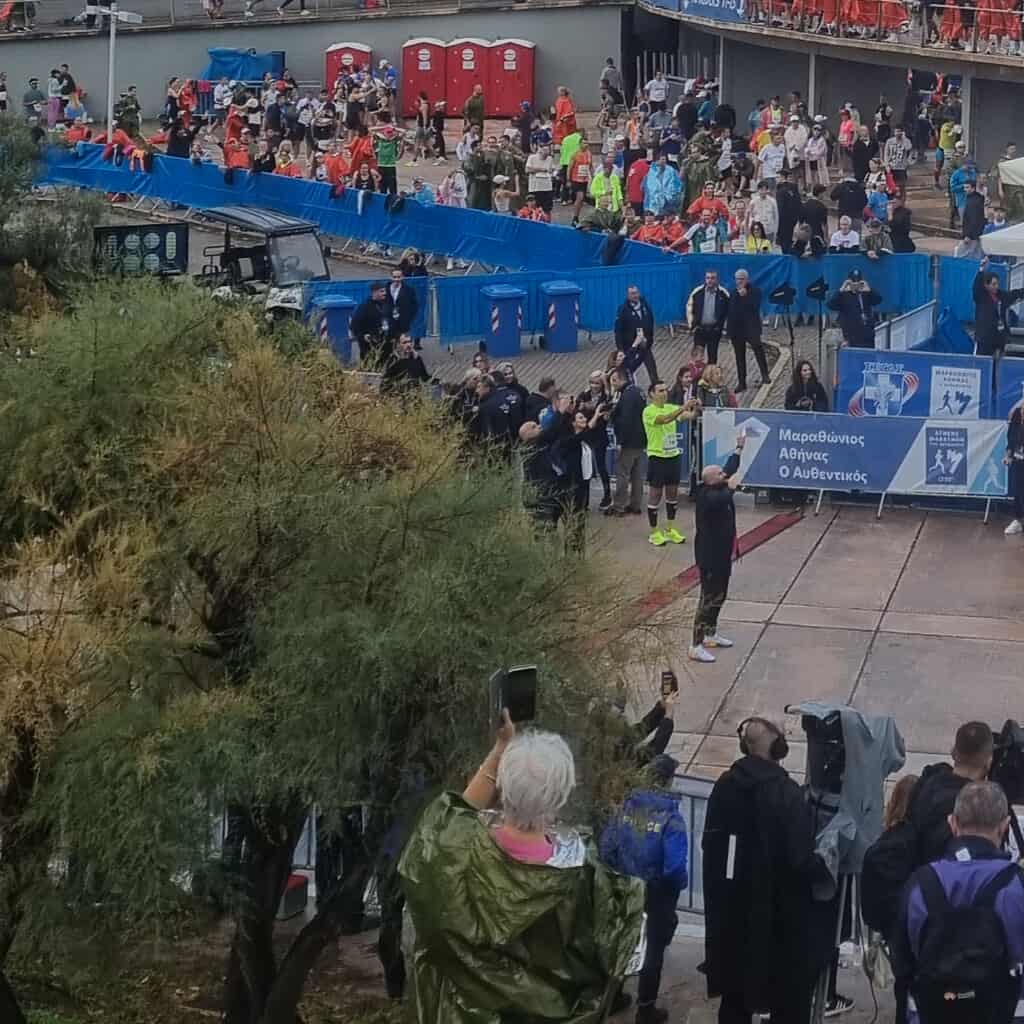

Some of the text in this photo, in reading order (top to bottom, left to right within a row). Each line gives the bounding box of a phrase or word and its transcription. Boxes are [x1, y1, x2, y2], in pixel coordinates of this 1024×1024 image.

[779, 429, 865, 447] Μαραθώνιος
[779, 448, 829, 464] Αθήνας
[779, 465, 868, 484] Ο Αυθεντικός
